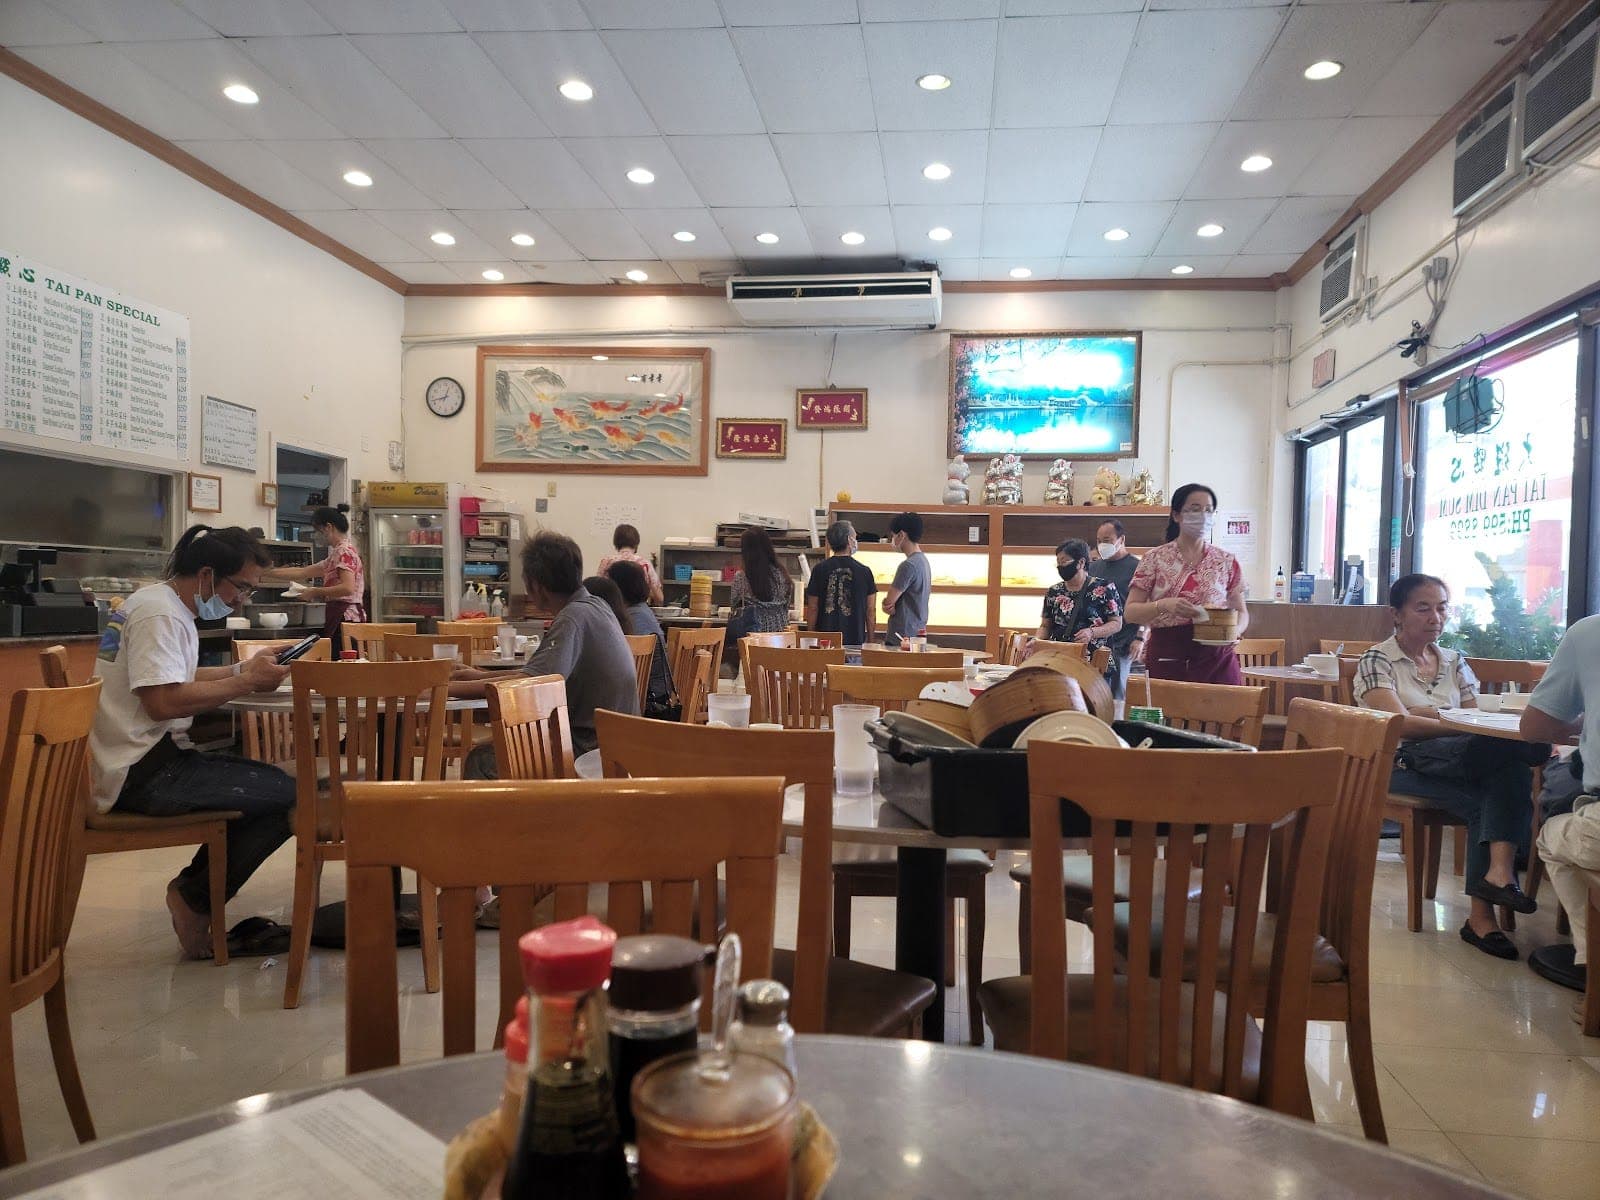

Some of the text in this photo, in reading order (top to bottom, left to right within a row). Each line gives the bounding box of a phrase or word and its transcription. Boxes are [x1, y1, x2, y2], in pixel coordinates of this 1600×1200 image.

[45, 277, 161, 327] TAI PAN SPECIAL
